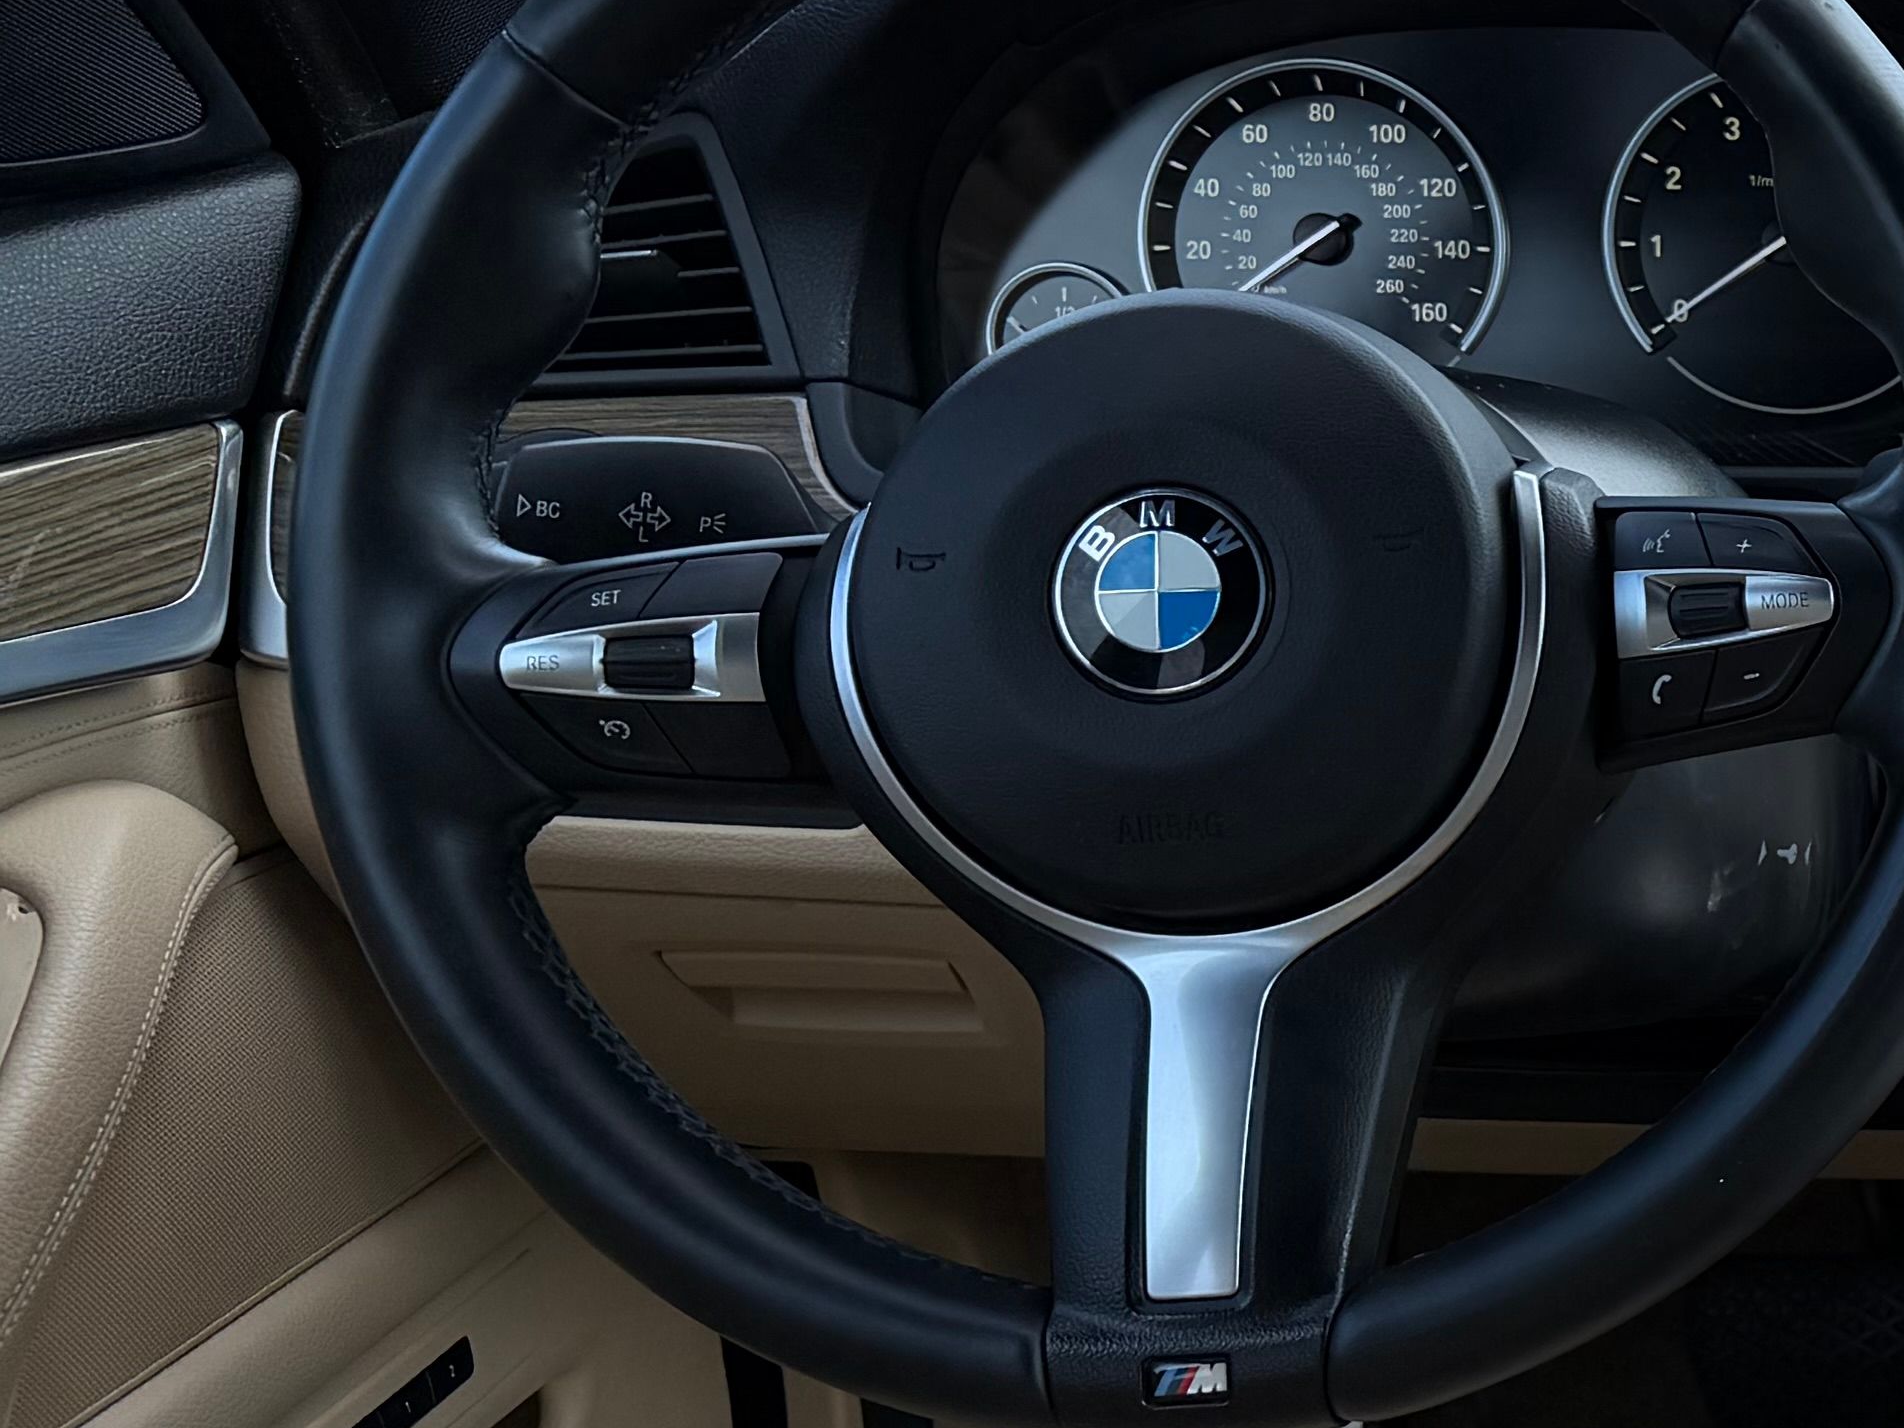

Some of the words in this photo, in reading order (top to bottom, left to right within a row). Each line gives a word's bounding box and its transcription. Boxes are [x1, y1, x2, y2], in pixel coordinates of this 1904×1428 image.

[1308, 102, 1335, 122] 80
[1241, 124, 1268, 143] 60
[1369, 123, 1406, 144] 100
[1723, 117, 1740, 141] 3
[1297, 152, 1322, 166] 120
[1327, 153, 1352, 166] 140
[1270, 164, 1295, 178] 100
[1353, 164, 1379, 178] 160
[1665, 166, 1682, 190] 2
[1194, 178, 1219, 197] 40
[1252, 183, 1271, 197] 80
[1370, 183, 1396, 197] 180
[1419, 178, 1456, 198] 120
[1239, 204, 1258, 219] 60
[1383, 204, 1411, 219] 200
[1232, 229, 1251, 243] 40
[1390, 229, 1418, 243] 220
[1186, 240, 1211, 259] 20
[1433, 239, 1470, 259] 140
[1650, 235, 1662, 258] 1
[1238, 255, 1257, 270] 20
[1388, 255, 1415, 269] 240
[1376, 279, 1404, 294] 260
[1411, 302, 1447, 323] 160
[640, 491, 653, 509] R
[535, 500, 561, 519] BC
[638, 526, 649, 543] L
[1078, 498, 1244, 565] BMW
[590, 589, 622, 607] SET
[1760, 590, 1810, 612] MODE
[525, 654, 561, 672] RES
